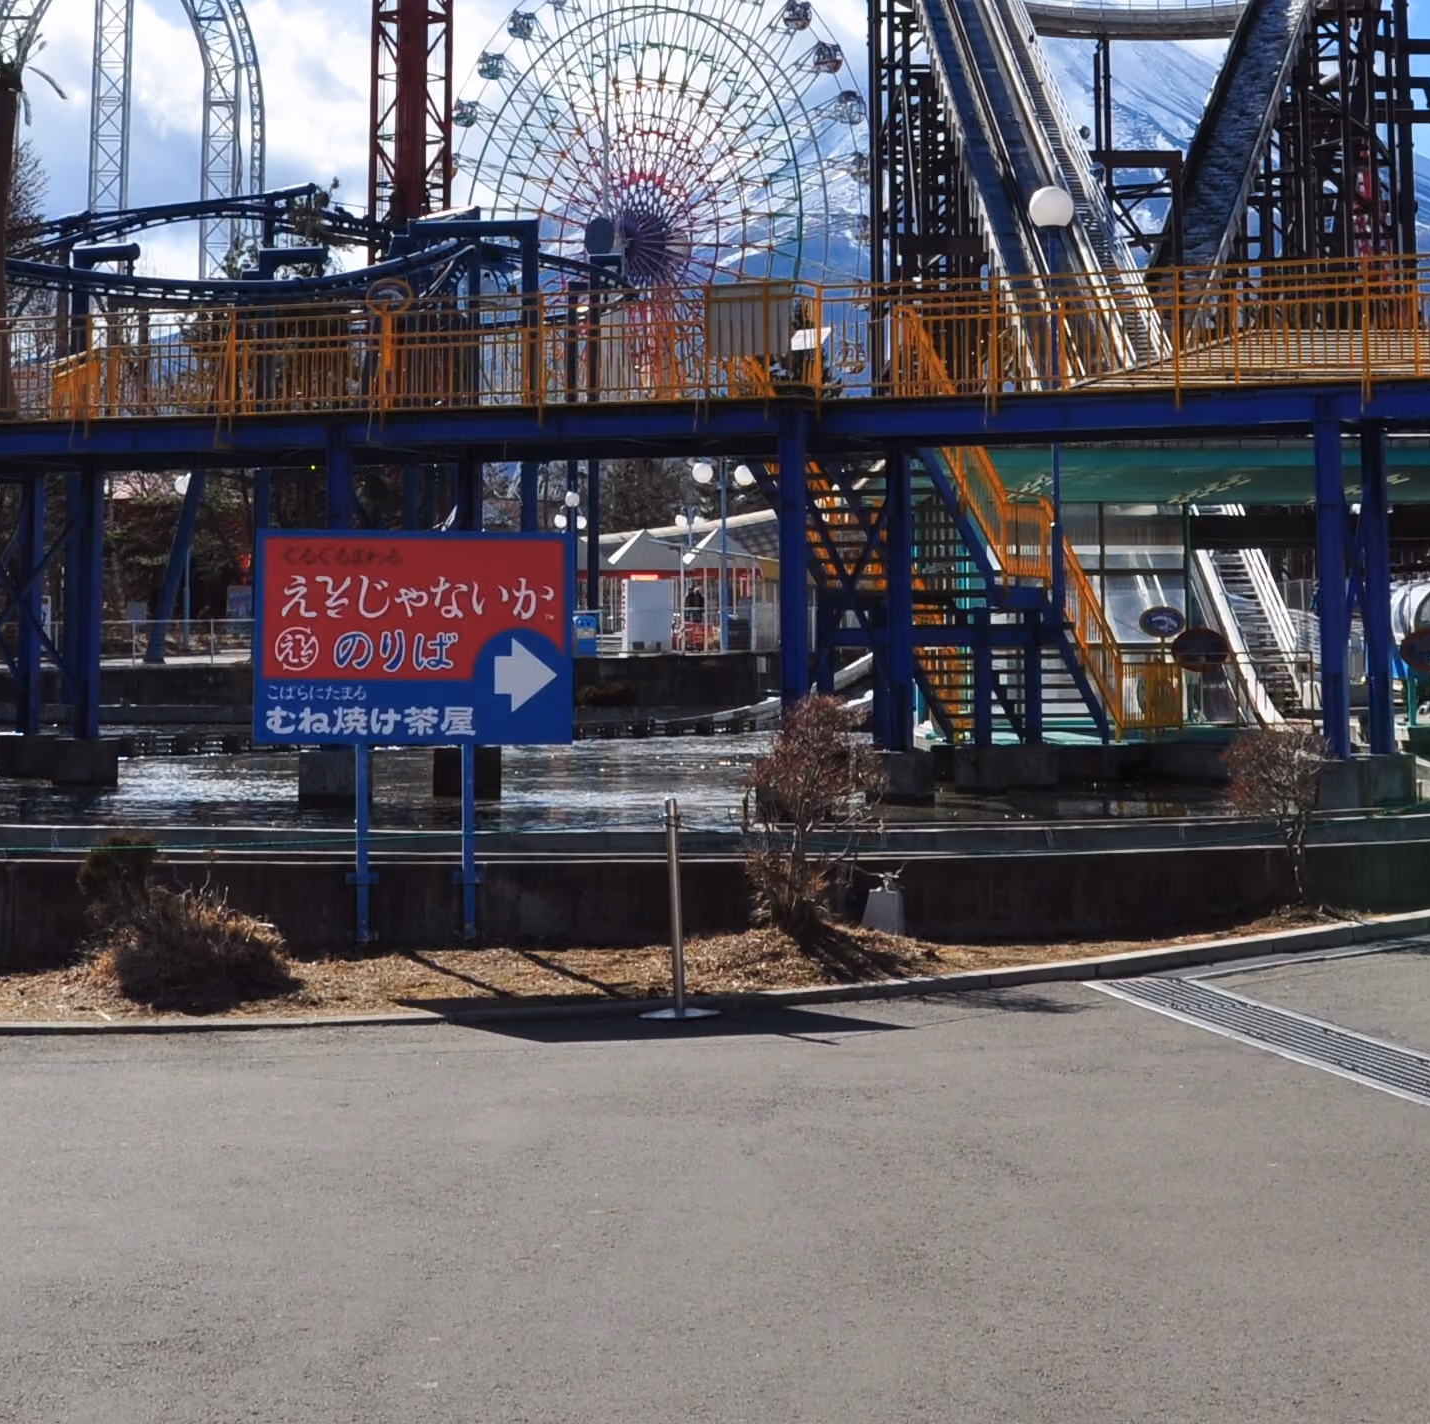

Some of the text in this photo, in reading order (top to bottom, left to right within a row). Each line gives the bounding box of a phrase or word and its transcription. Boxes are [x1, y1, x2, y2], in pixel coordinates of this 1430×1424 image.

[333, 629, 459, 672] のりば
[267, 684, 367, 701] こばらにたまる
[265, 705, 477, 737] むね焼け茶屋
